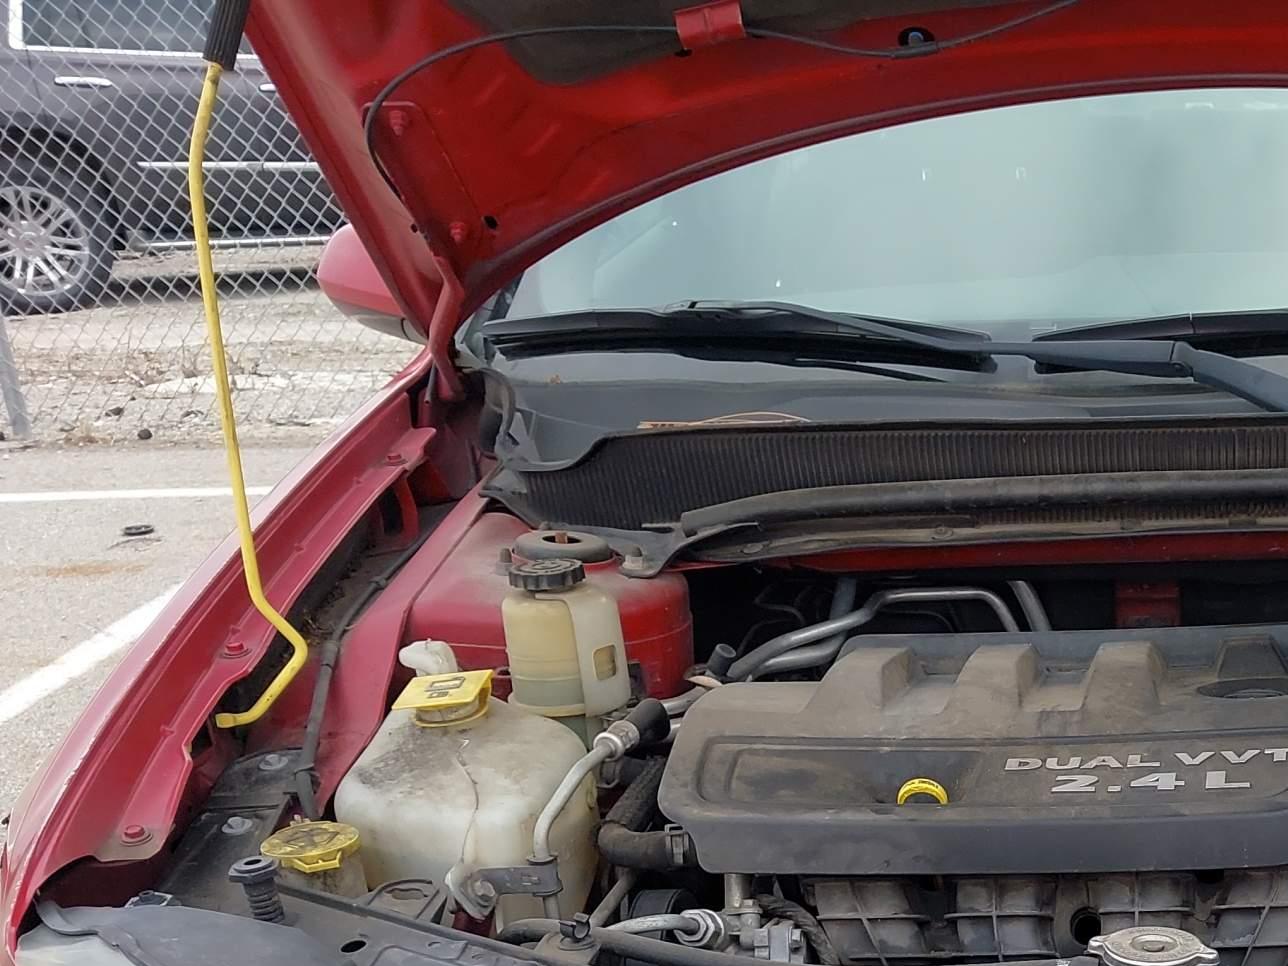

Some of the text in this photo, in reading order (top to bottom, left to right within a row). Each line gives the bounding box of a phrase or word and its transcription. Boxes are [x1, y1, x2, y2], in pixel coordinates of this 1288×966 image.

[1004, 754, 1161, 771] DUAL
[1051, 770, 1251, 793] 2.4 L
